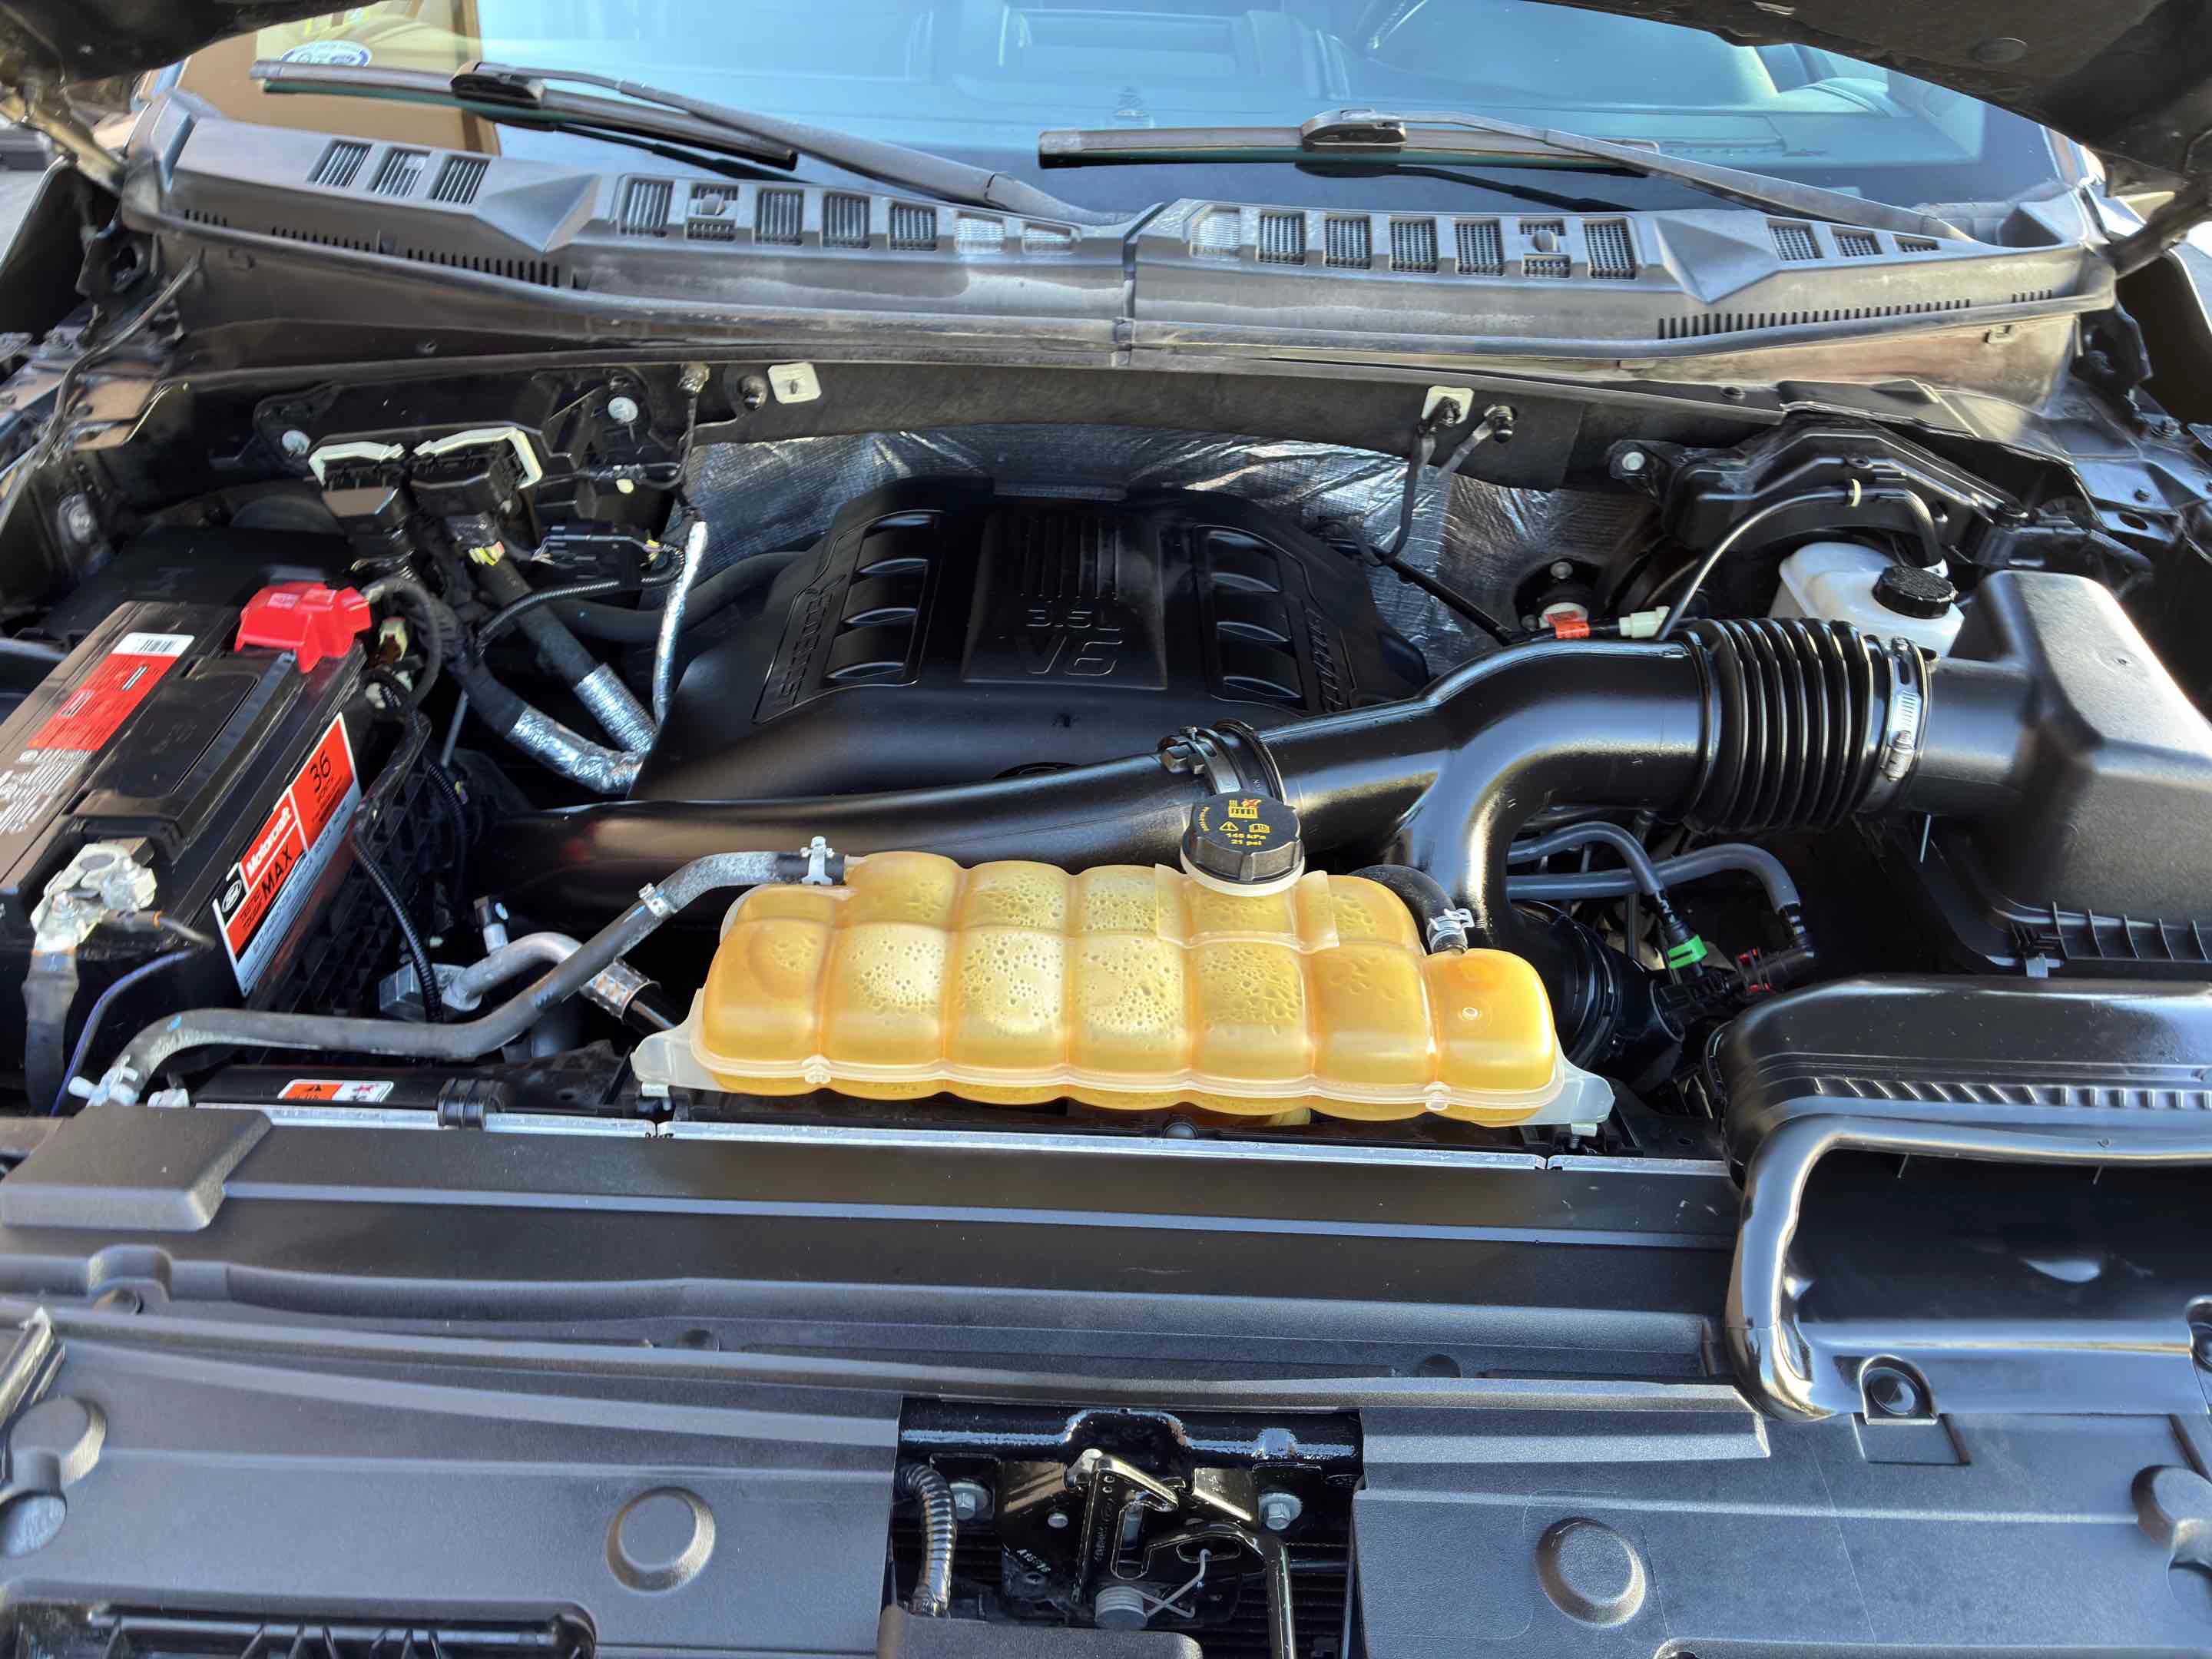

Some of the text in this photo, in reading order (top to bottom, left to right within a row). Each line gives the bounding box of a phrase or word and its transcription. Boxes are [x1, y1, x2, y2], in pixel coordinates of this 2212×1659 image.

[1015, 635, 1124, 677] V6
[310, 751, 331, 793] 36
[261, 846, 293, 898] MAX
